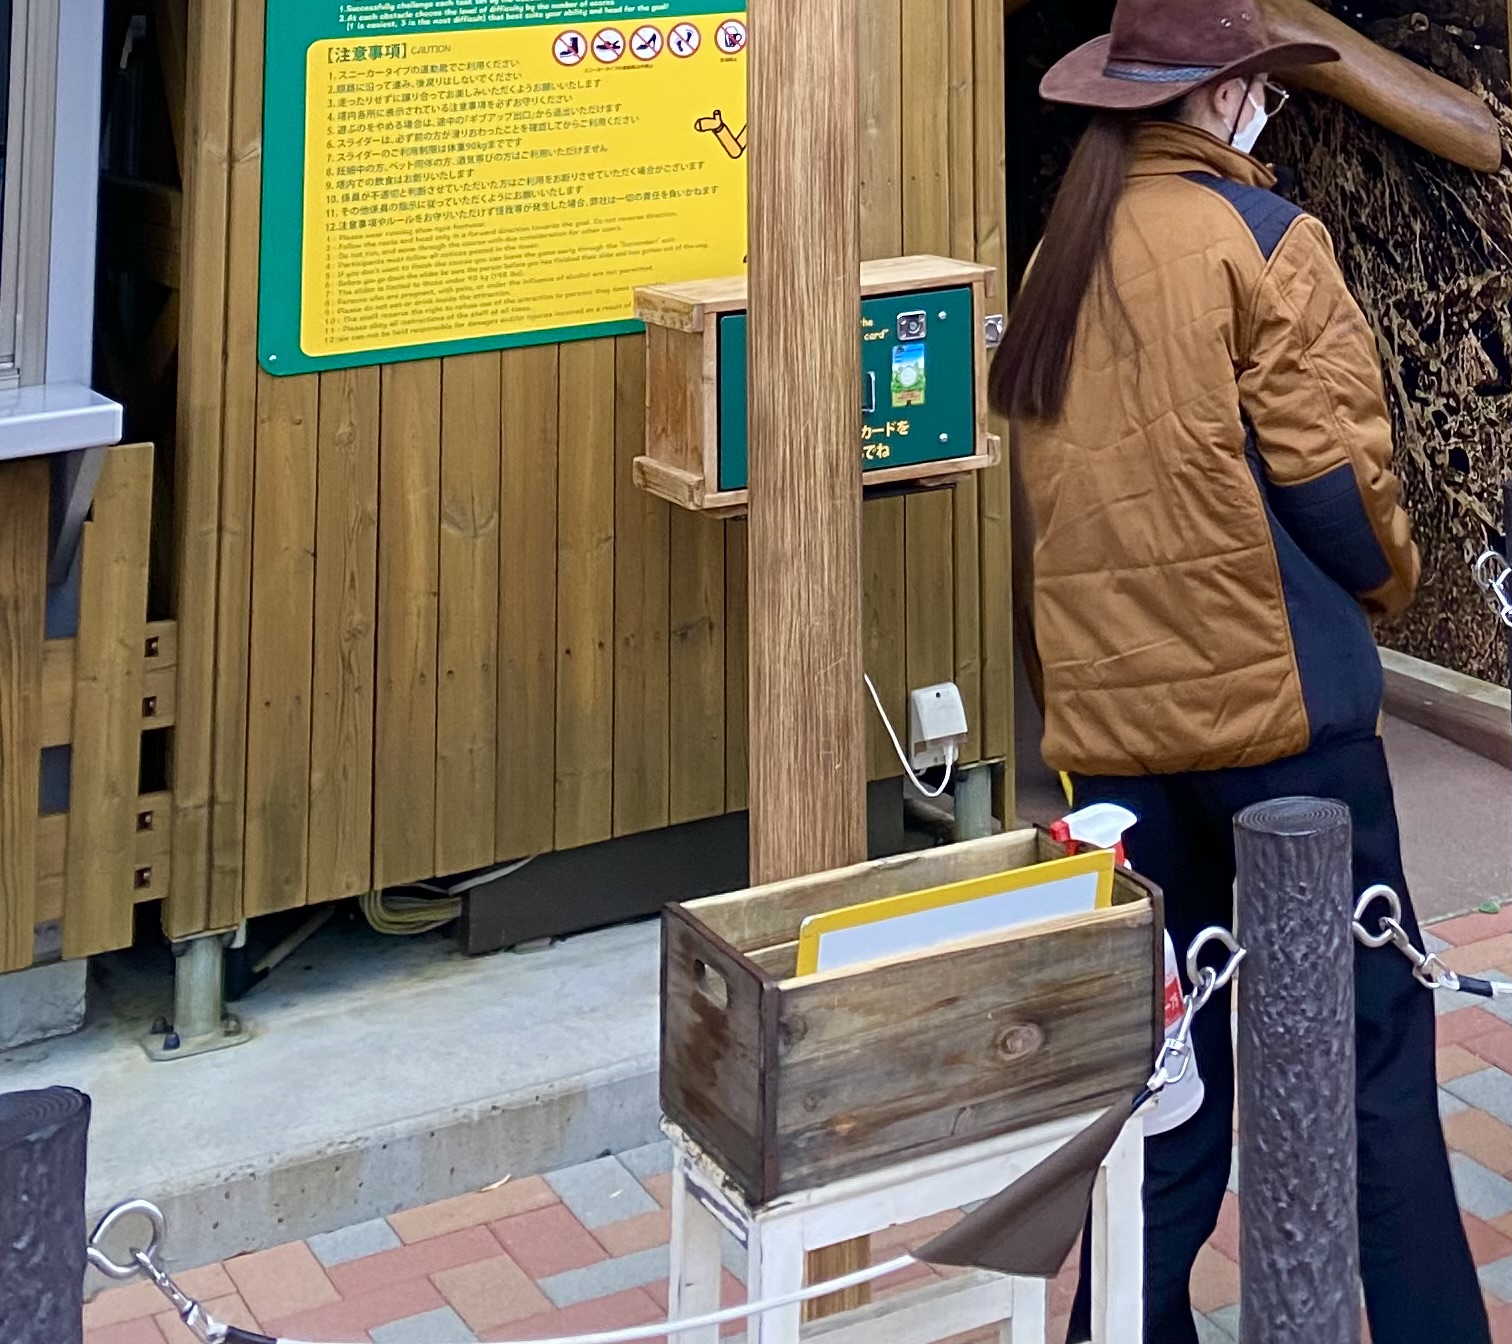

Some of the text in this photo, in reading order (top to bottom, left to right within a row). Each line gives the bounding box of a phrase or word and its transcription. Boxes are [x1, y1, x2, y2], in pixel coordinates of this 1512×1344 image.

[328, 42, 406, 64] 【注意事項】
[410, 45, 451, 55] CAUTION
[861, 318, 873, 327] he
[861, 442, 890, 460] でね
